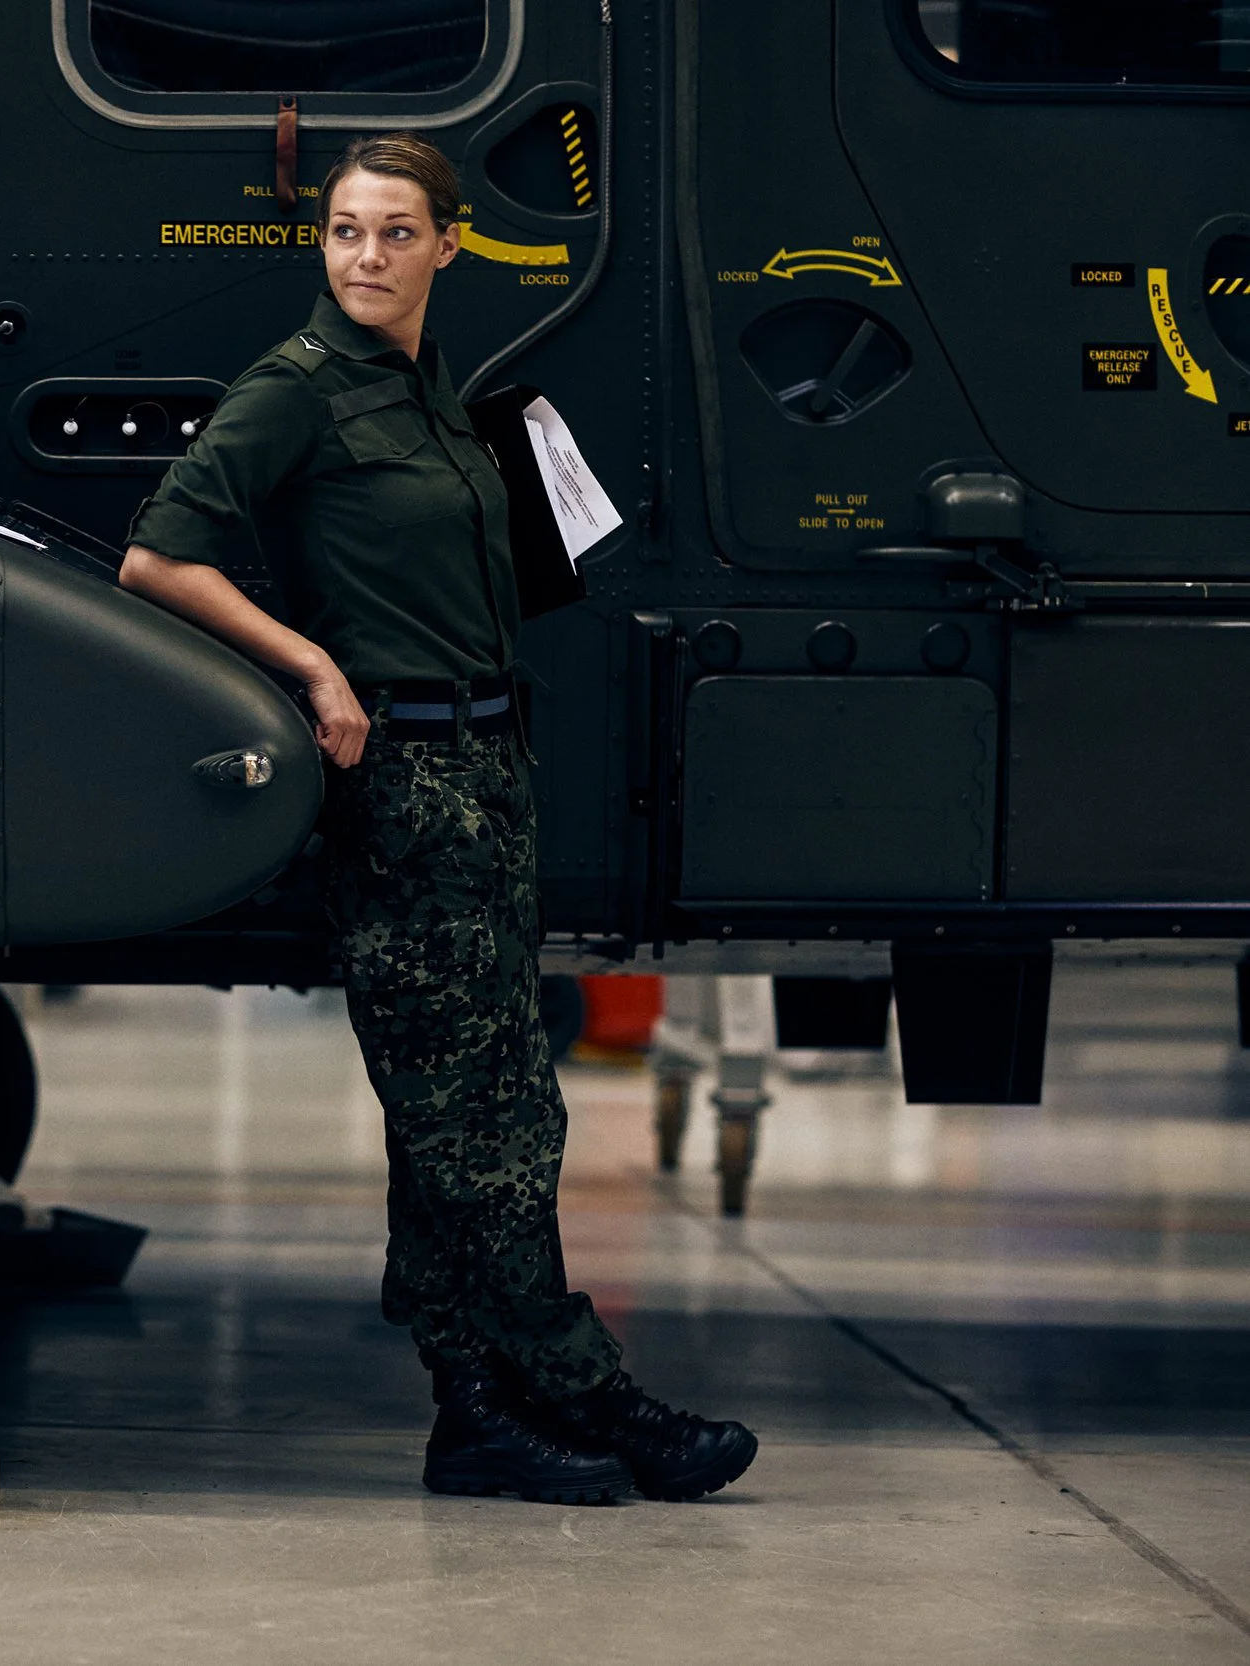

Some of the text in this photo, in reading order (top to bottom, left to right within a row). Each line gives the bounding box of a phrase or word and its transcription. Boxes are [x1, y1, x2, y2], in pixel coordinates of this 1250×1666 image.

[243, 185, 320, 198] PULL TAB
[160, 223, 291, 245] EMERGENCY
[852, 236, 881, 248] OPEN
[519, 273, 570, 287] LOCKED
[717, 271, 759, 282] LOCKED
[1081, 270, 1123, 282] LOCKED
[1151, 283, 1192, 374] RESCUE
[1089, 350, 1150, 361] EMERGENCY
[1097, 361, 1141, 373] RELEASE
[1106, 373, 1132, 385] ONLY
[815, 493, 869, 506] PULL OUT
[798, 517, 885, 530] SLIDE TO OPEN
